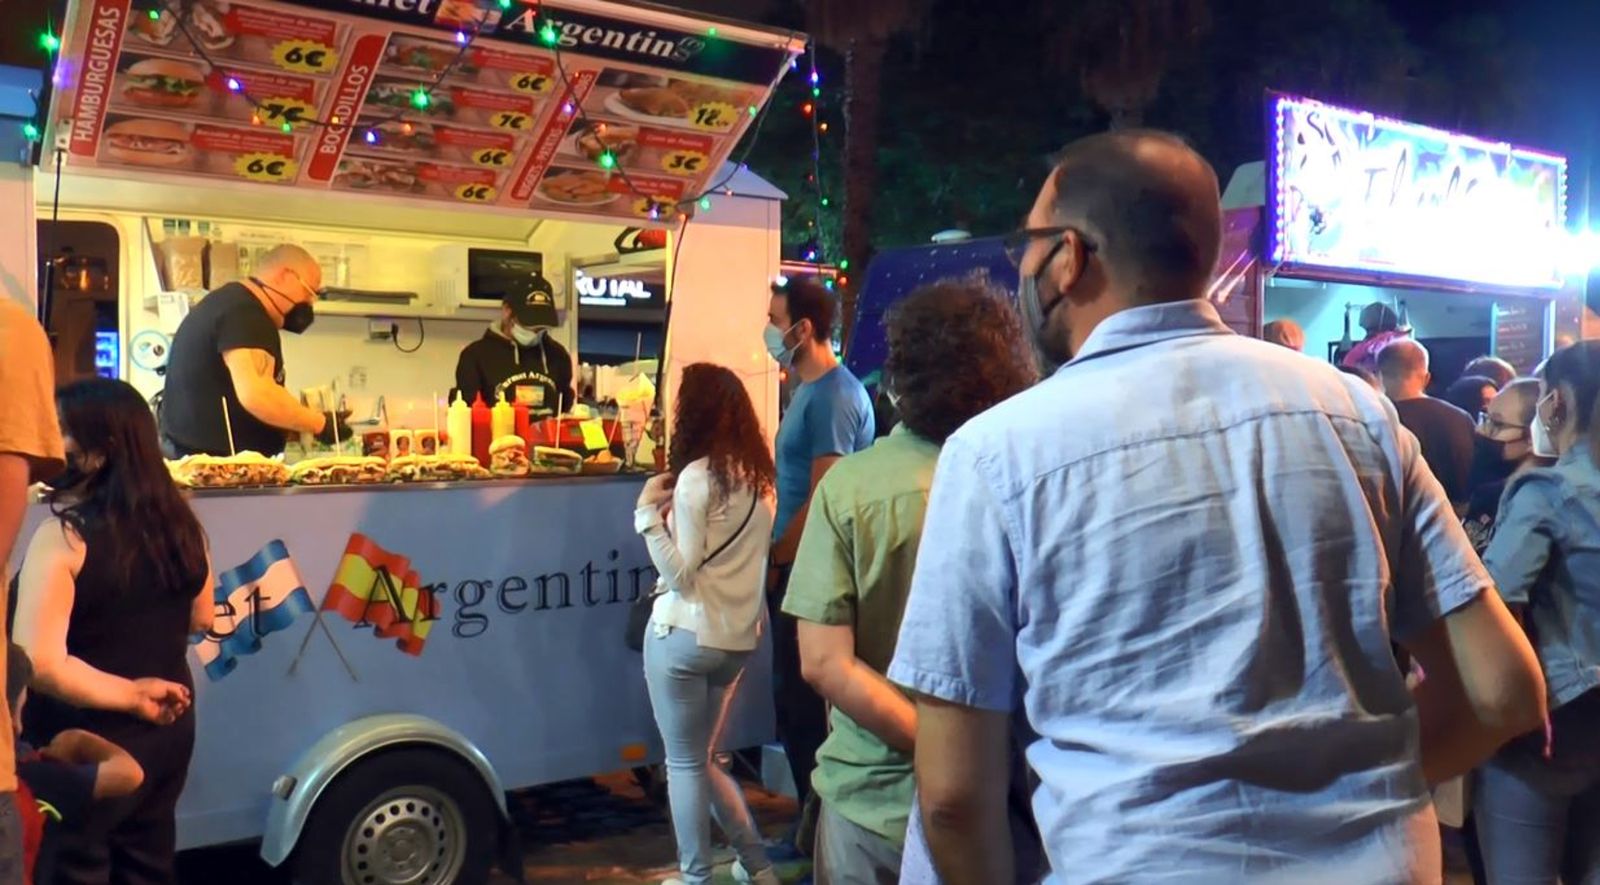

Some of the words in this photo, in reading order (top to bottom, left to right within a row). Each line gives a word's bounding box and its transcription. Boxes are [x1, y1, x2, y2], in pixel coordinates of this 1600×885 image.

[284, 46, 326, 68] 6€
[73, 5, 121, 142] HAMBURGUESAS
[517, 75, 546, 91] 6€
[268, 104, 304, 122] 7€
[320, 65, 369, 154] BOCADILLOS
[499, 114, 526, 129] 7€
[479, 151, 507, 165] 6€
[669, 155, 702, 170] 3€
[247, 159, 285, 176] 6€
[462, 186, 490, 199] 6€
